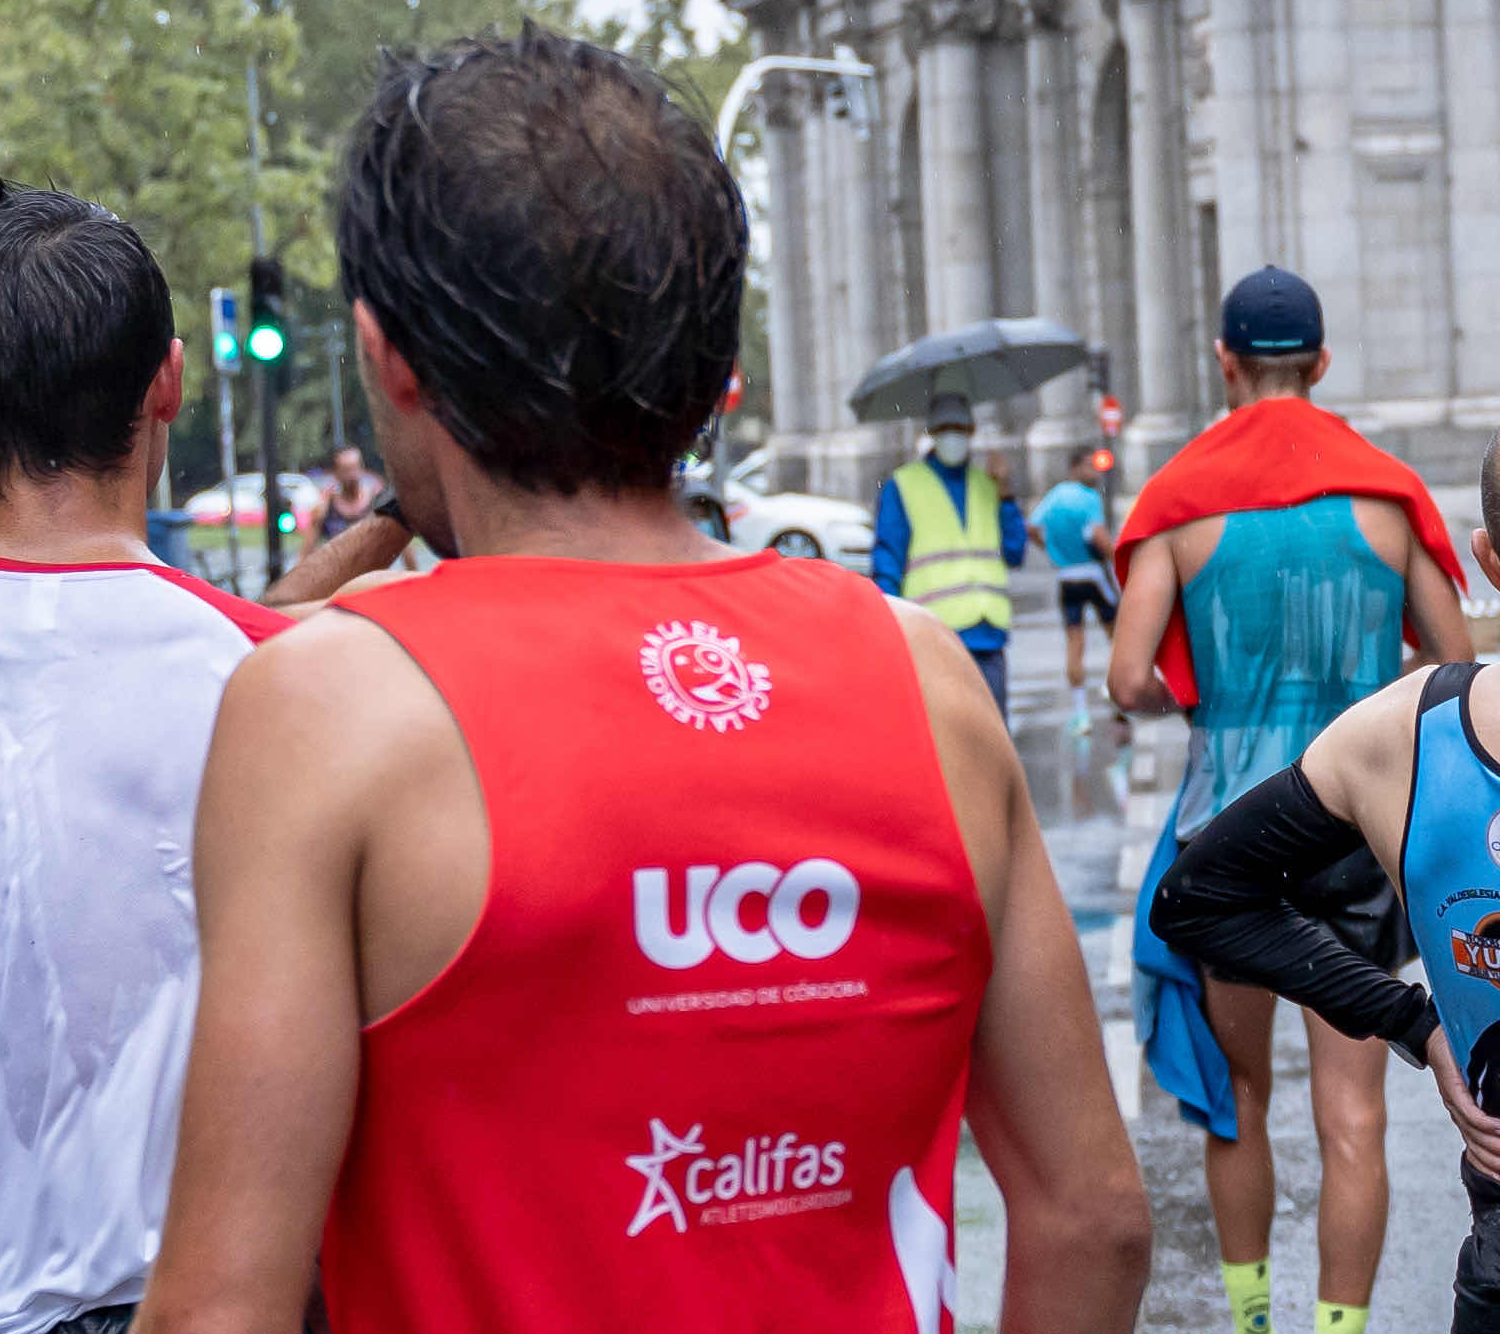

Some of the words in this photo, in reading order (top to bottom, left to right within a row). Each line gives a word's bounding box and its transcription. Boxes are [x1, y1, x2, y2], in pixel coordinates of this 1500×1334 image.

[633, 857, 861, 970] UCO
[626, 990, 756, 1015] UNIVERSIDAD
[756, 987, 781, 1006] DE
[782, 979, 868, 1003] CÓRDOBA
[685, 1132, 846, 1204] califas
